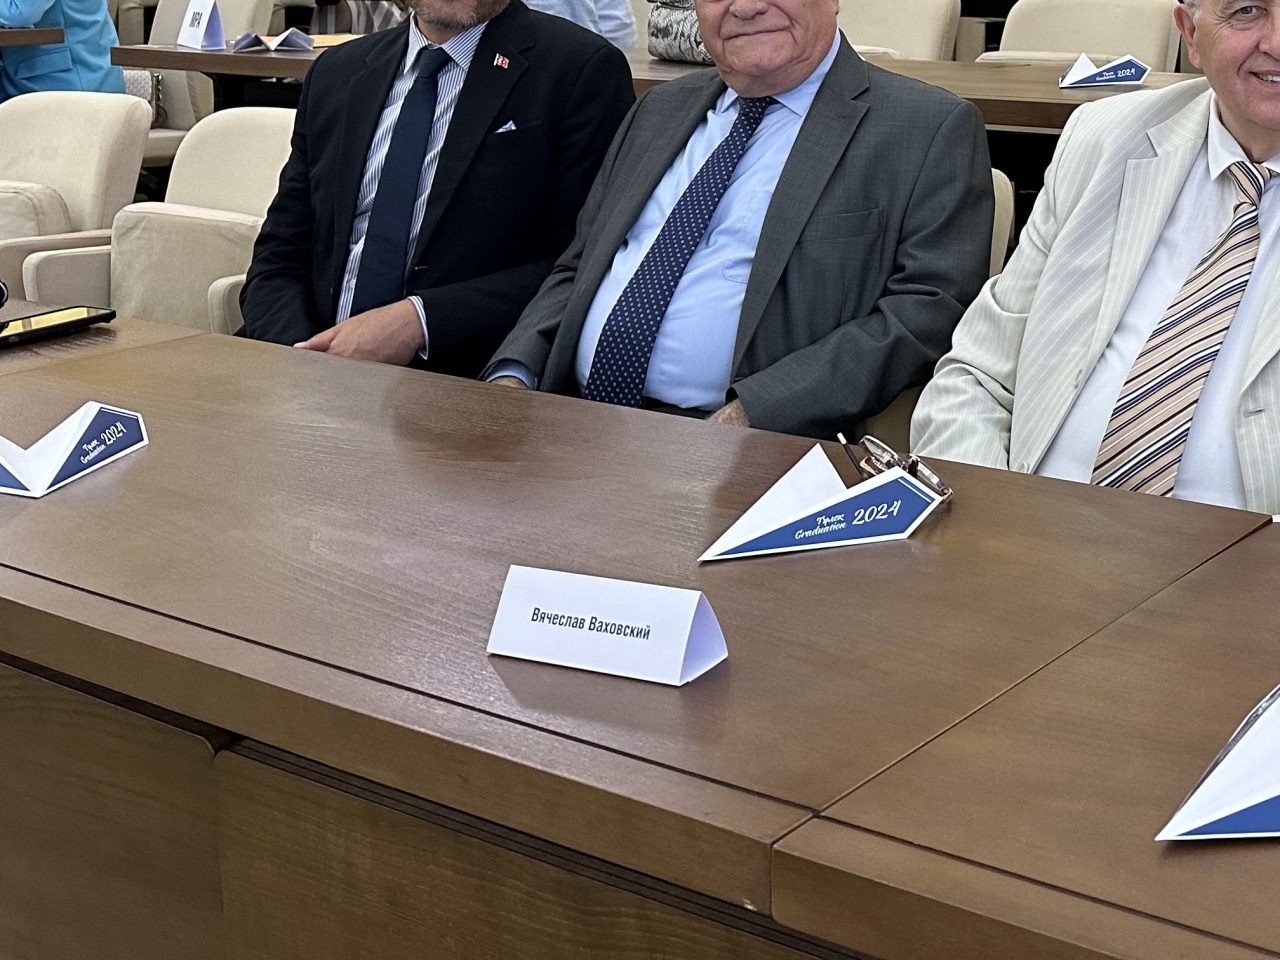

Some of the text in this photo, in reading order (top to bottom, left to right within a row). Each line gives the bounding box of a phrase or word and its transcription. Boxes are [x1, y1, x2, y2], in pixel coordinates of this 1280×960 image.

[1117, 68, 1136, 77] 2024
[100, 421, 128, 445] 2024
[852, 499, 902, 525] 2024
[794, 521, 848, 540] Graduation
[531, 607, 651, 640] Вячеслав Ваховский
